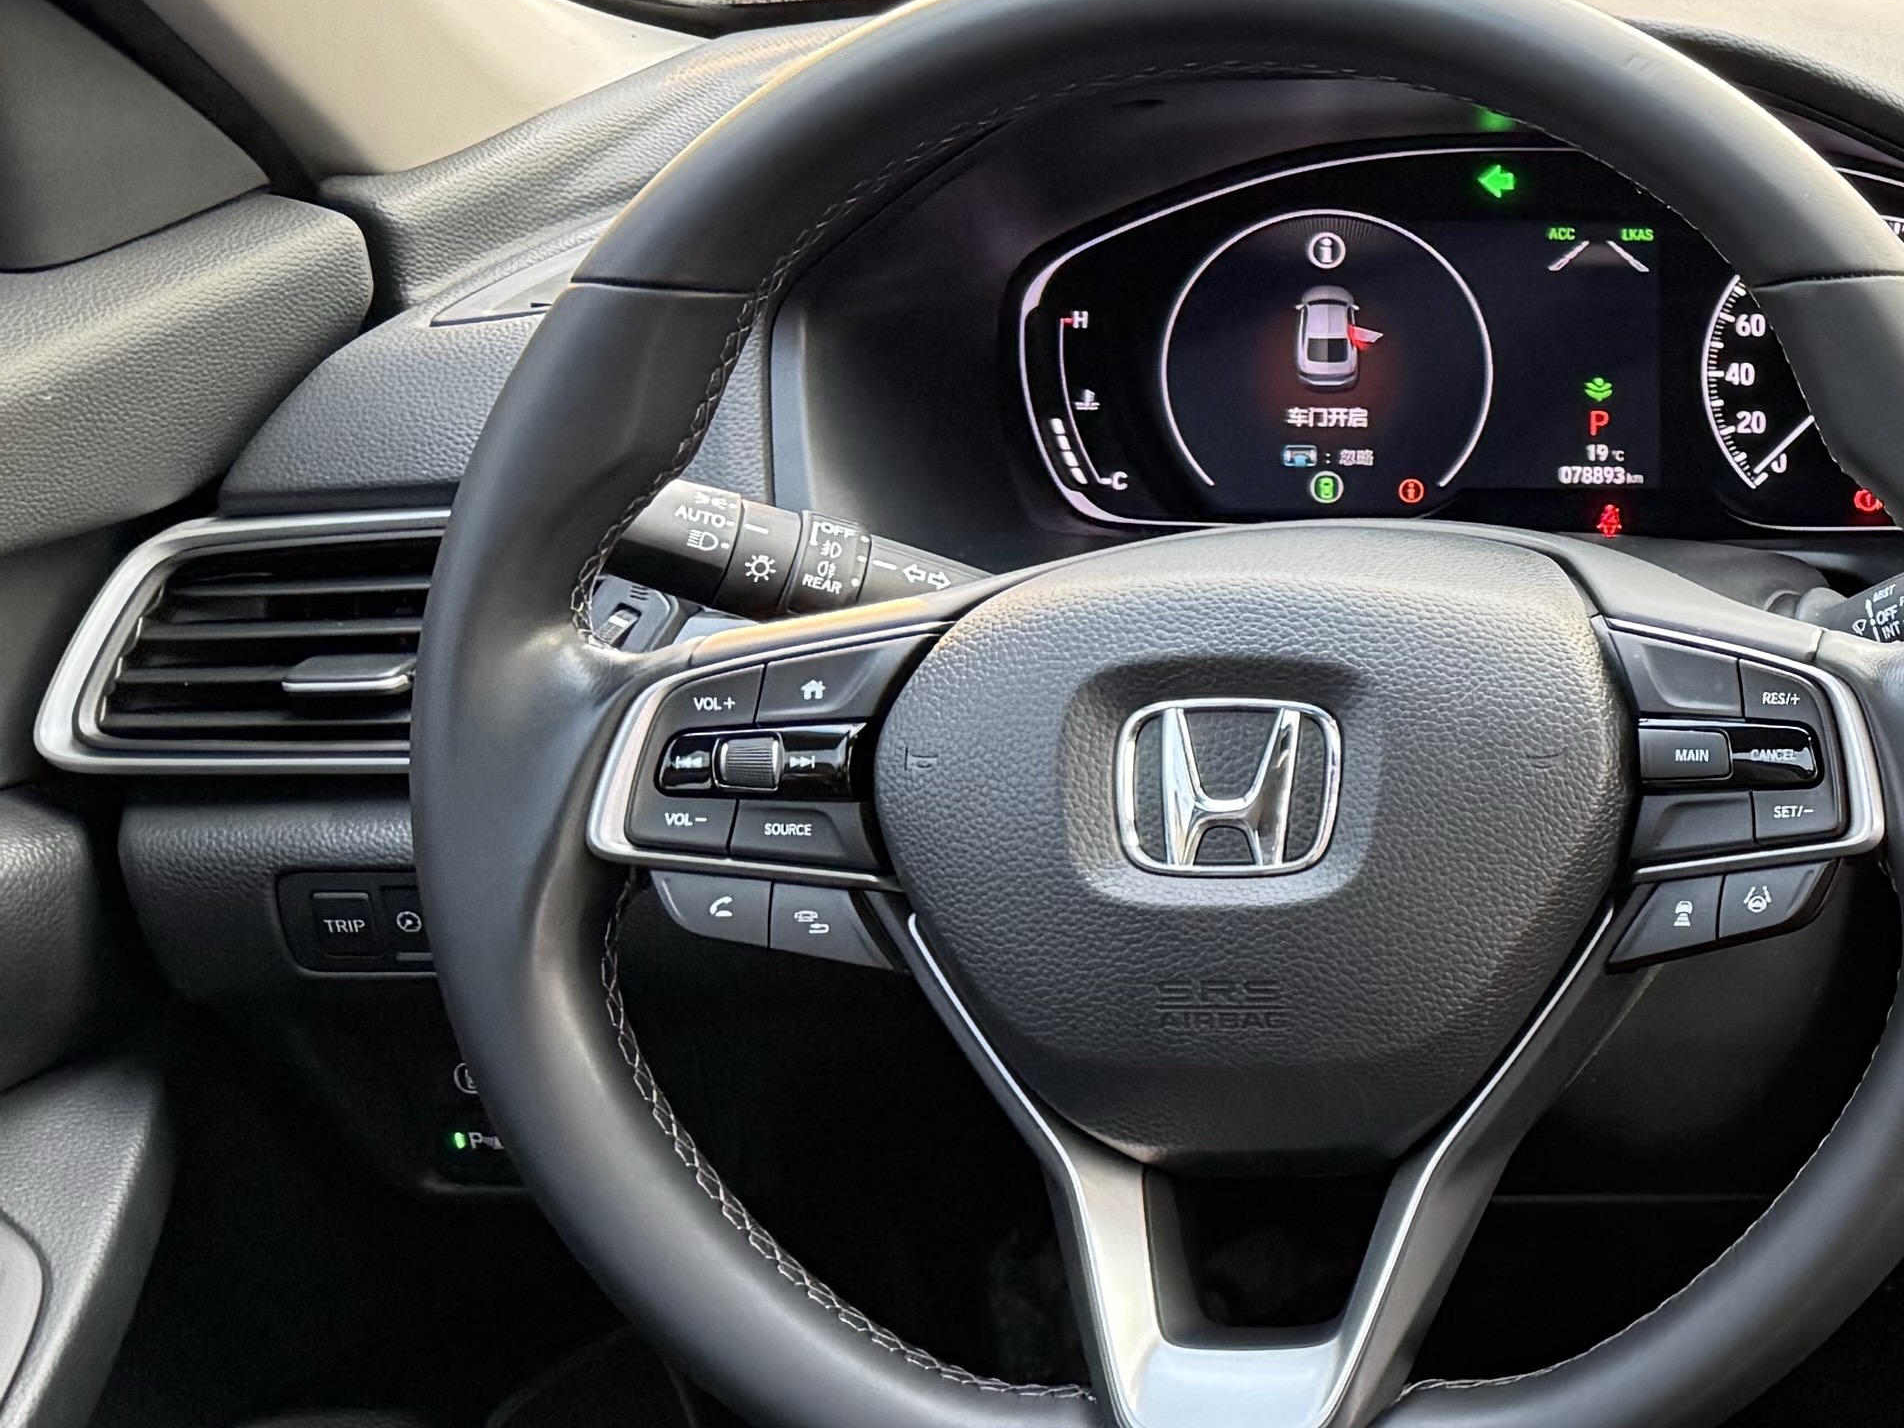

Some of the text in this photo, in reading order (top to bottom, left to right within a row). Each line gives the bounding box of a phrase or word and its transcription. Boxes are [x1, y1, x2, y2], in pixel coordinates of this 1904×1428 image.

[1547, 227, 1576, 241] ACC
[1621, 228, 1655, 242] LKAS
[1072, 310, 1089, 329] H
[1735, 314, 1766, 337] 60
[1725, 362, 1756, 386] 40
[1284, 407, 1369, 428] 车门开启
[1589, 410, 1610, 437] P
[1736, 411, 1767, 434] 20
[1585, 443, 1609, 462] 19
[1112, 471, 1129, 491] C
[1558, 465, 1626, 485] 078893
[674, 505, 726, 527] AUTO
[819, 522, 856, 540] OFF
[802, 573, 842, 595] REAR
[1876, 604, 1898, 625] OFF
[1881, 621, 1900, 640] INT
[1762, 692, 1800, 706] RES/+
[1675, 749, 1709, 762] MAIN
[1750, 748, 1797, 761] CANCEL
[764, 823, 812, 836] SOURCE
[323, 918, 365, 934] TRIP
